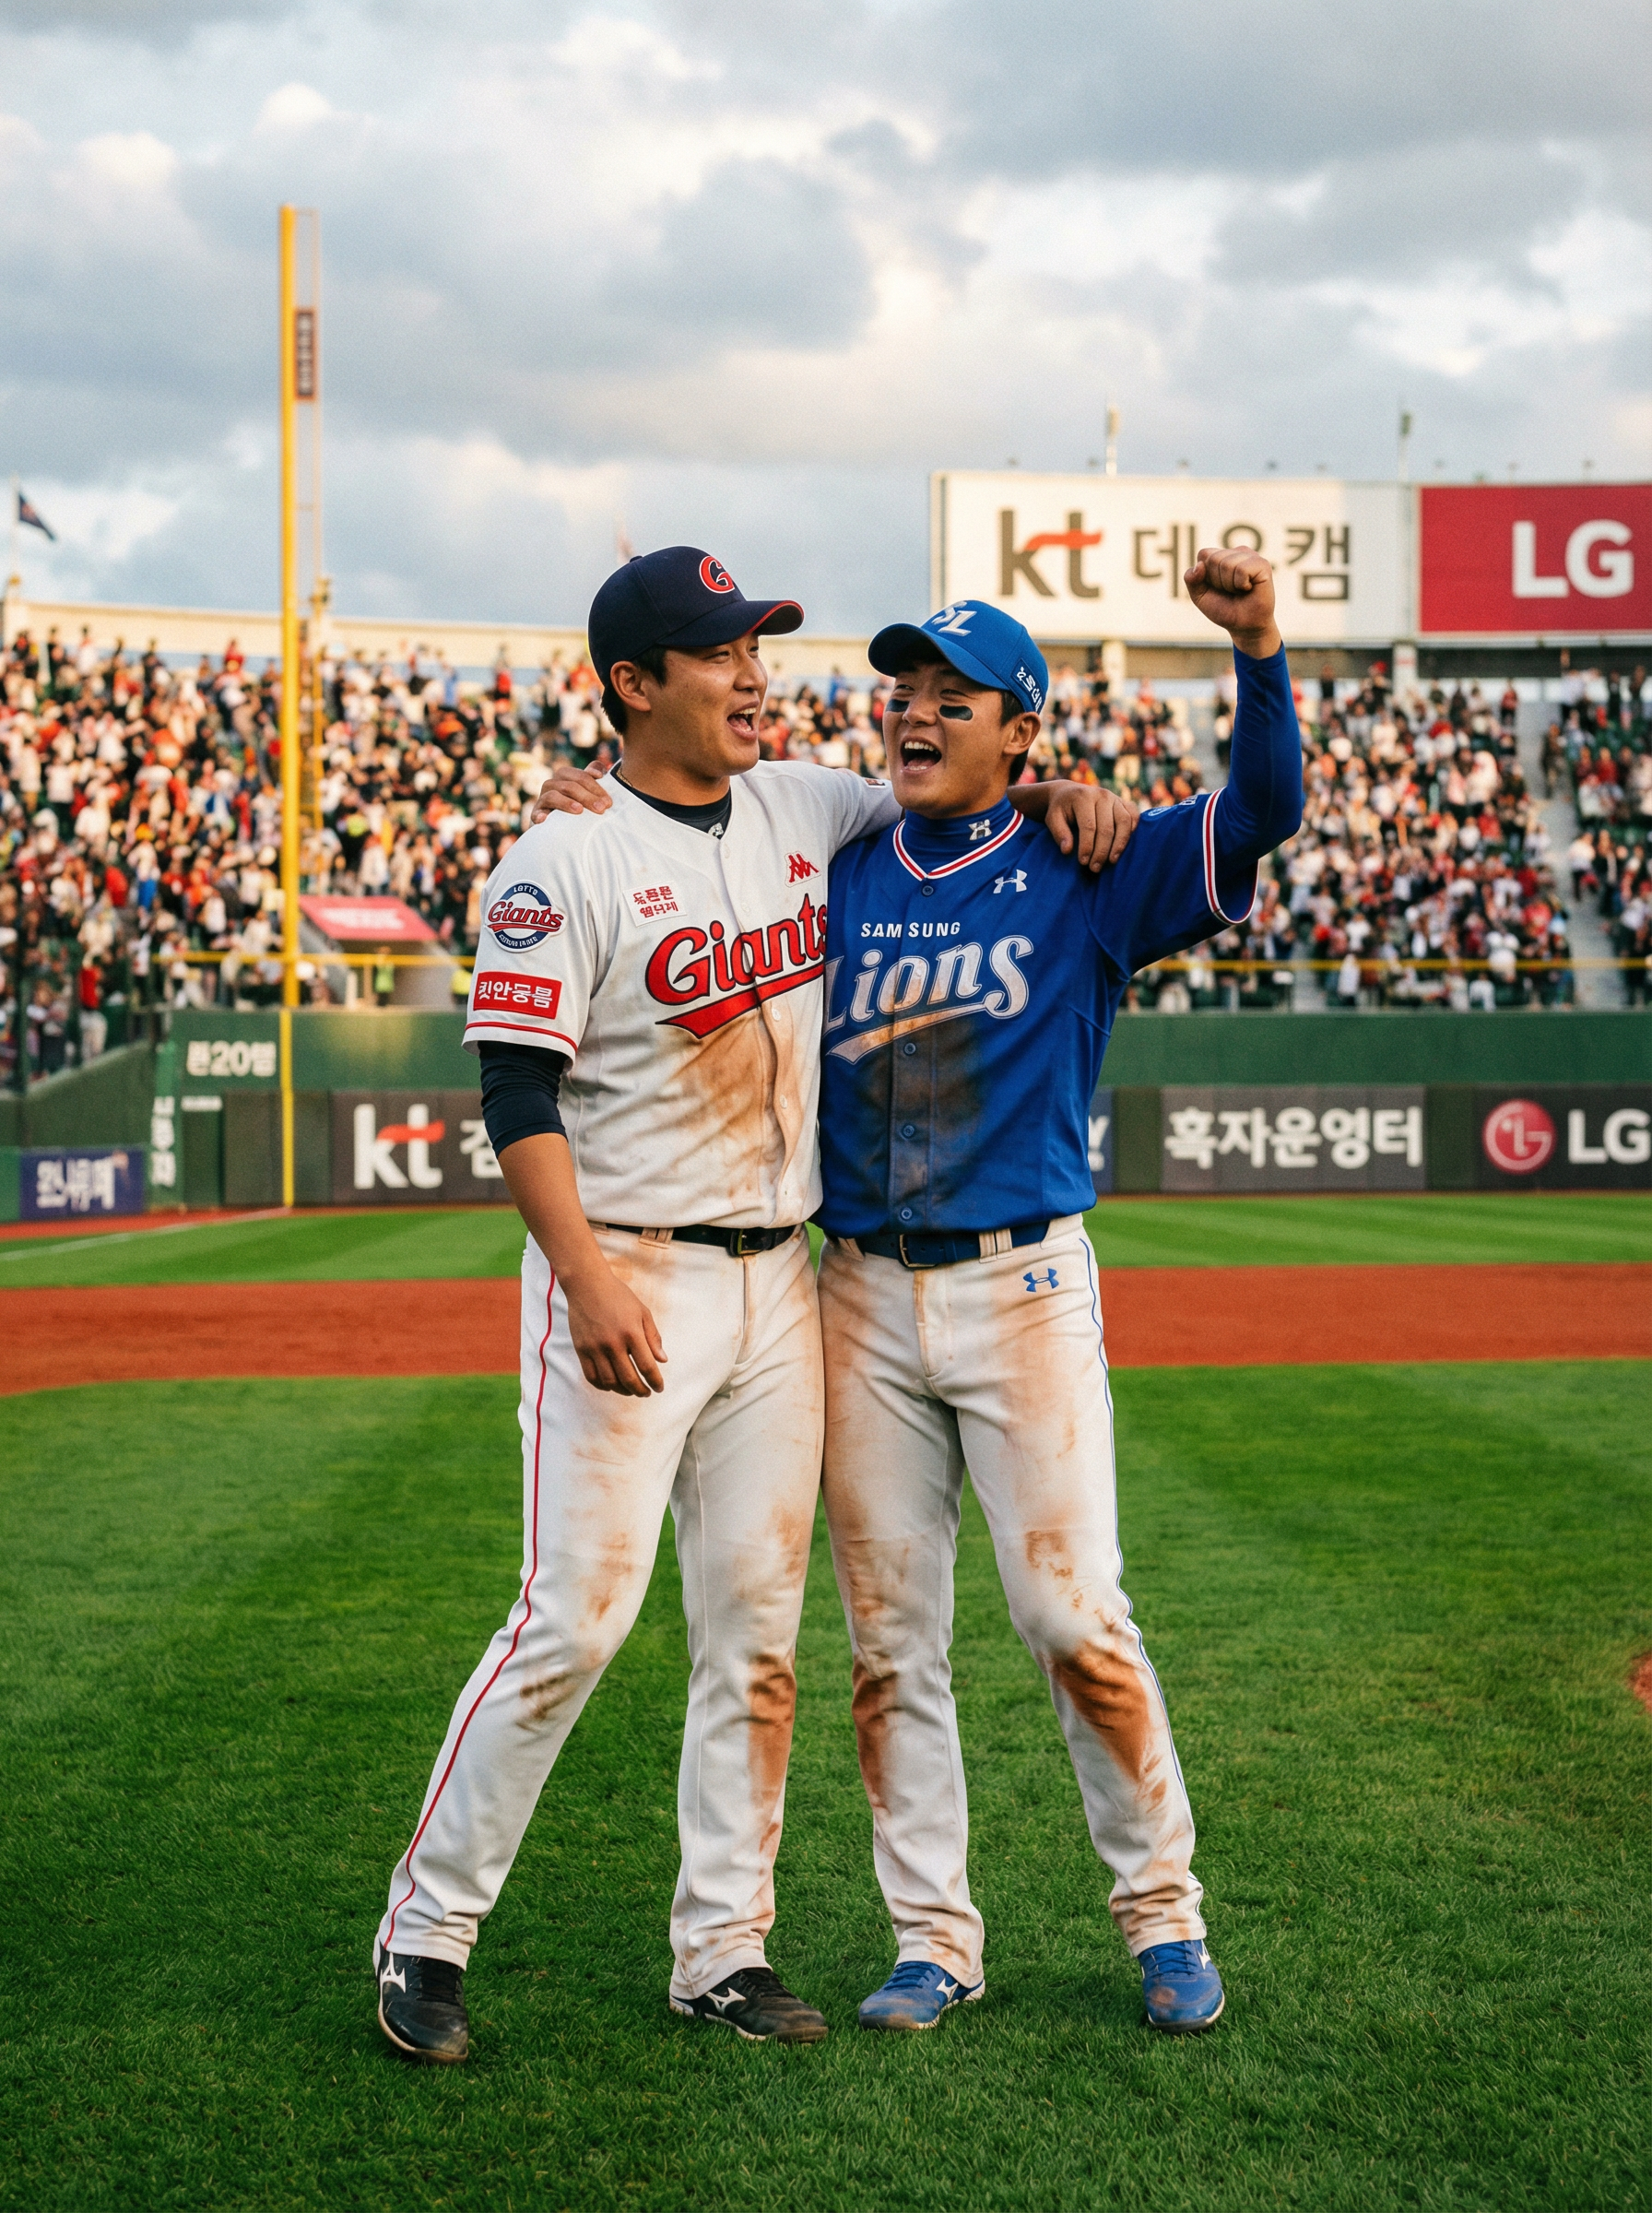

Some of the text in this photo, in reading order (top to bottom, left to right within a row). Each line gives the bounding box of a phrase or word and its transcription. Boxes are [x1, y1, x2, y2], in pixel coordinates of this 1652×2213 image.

[699, 555, 735, 593] G
[1001, 509, 1103, 598] kt
[1512, 519, 1634, 598] LG
[488, 901, 564, 928] Giants
[353, 1103, 445, 1189] kt
[1568, 1108, 1651, 1165] LG
